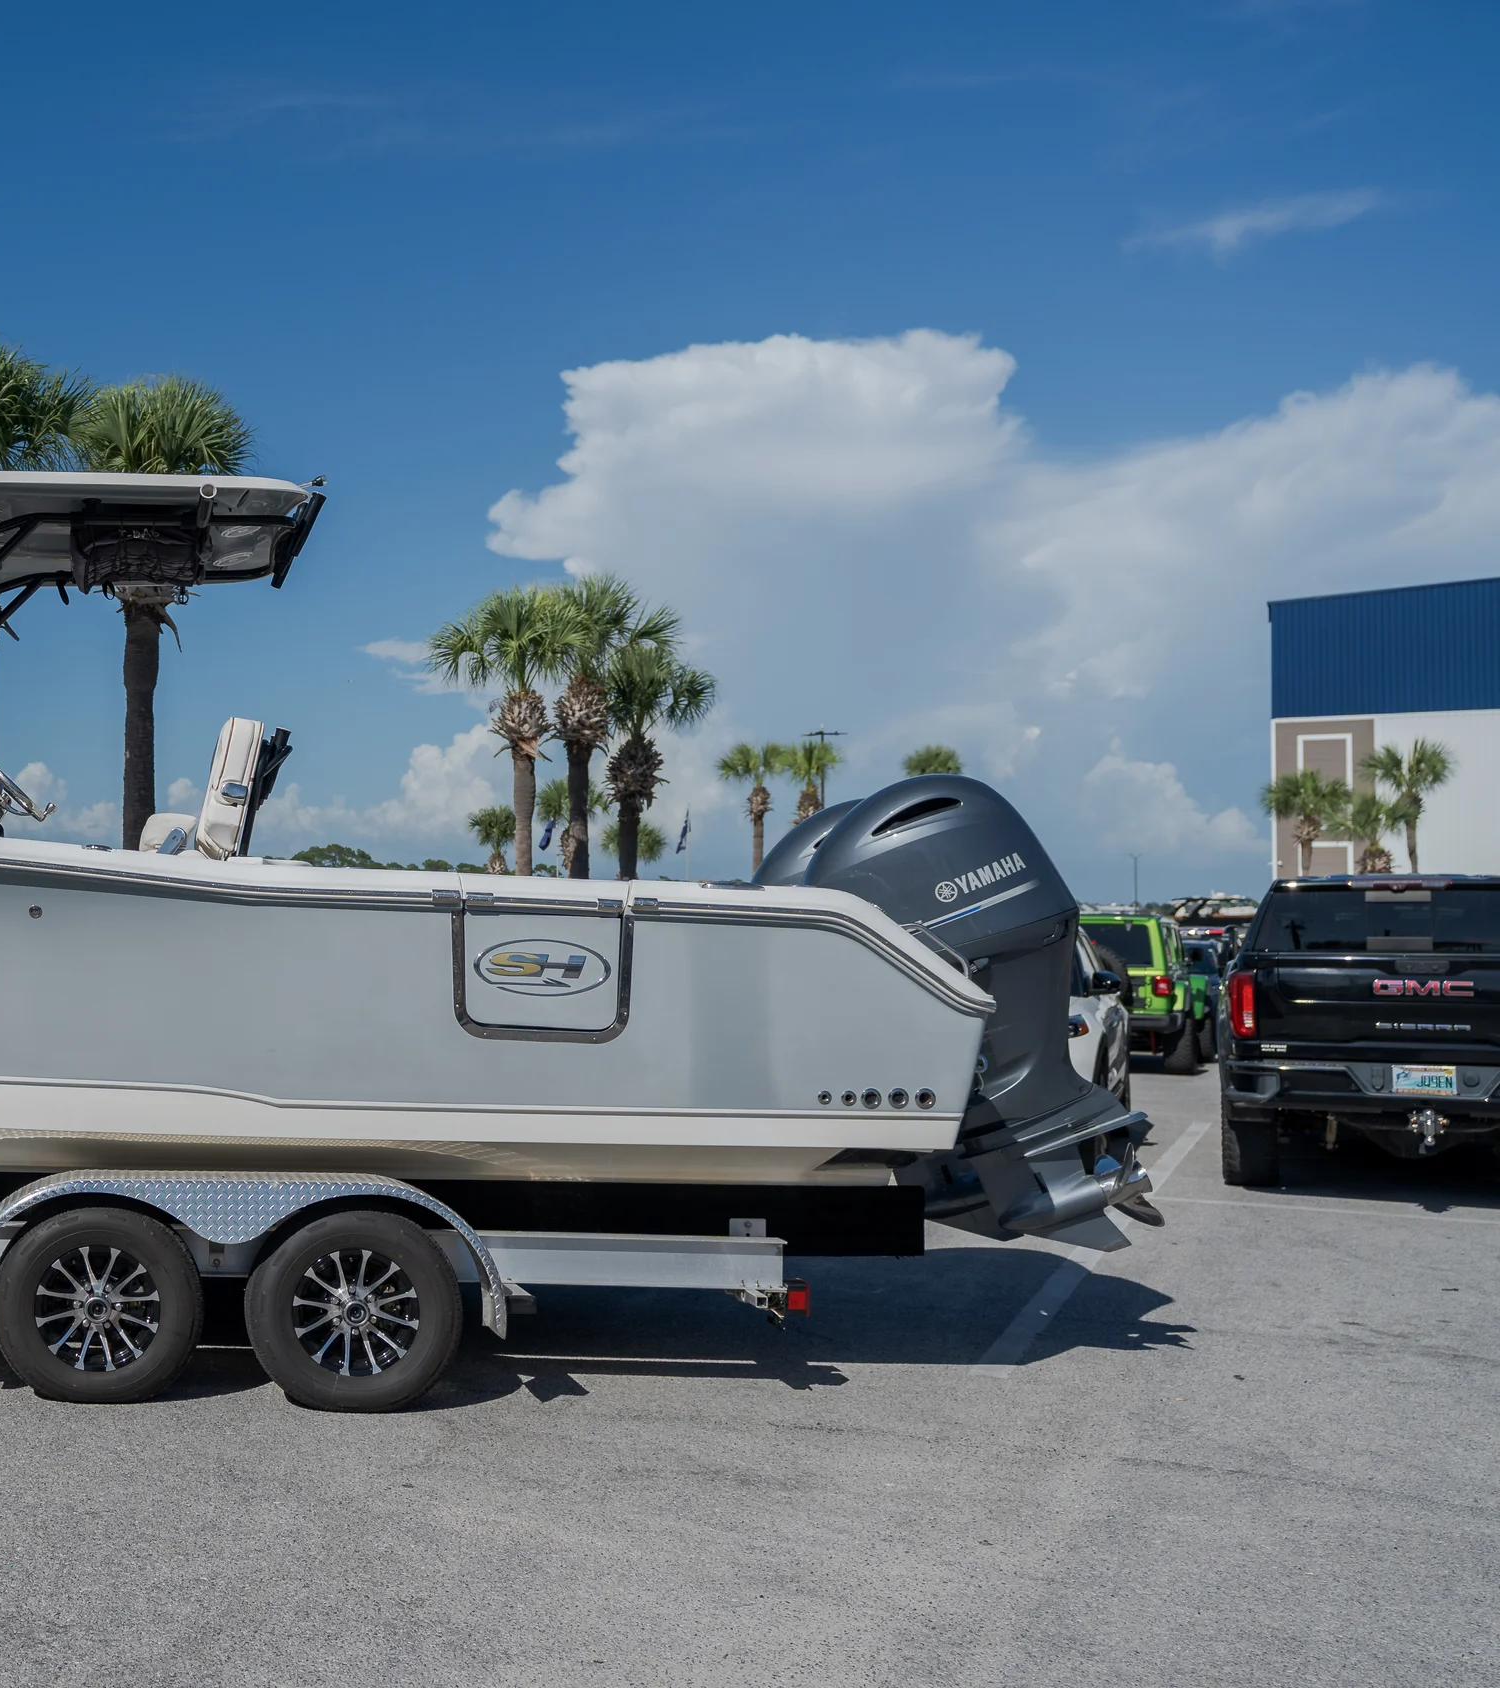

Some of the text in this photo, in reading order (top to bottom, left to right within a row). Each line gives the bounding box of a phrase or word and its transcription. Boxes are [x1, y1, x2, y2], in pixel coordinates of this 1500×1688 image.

[953, 852, 1027, 894] YAMAHA
[1373, 979, 1475, 997] GMC
[1375, 1021, 1471, 1031] SIERRA
